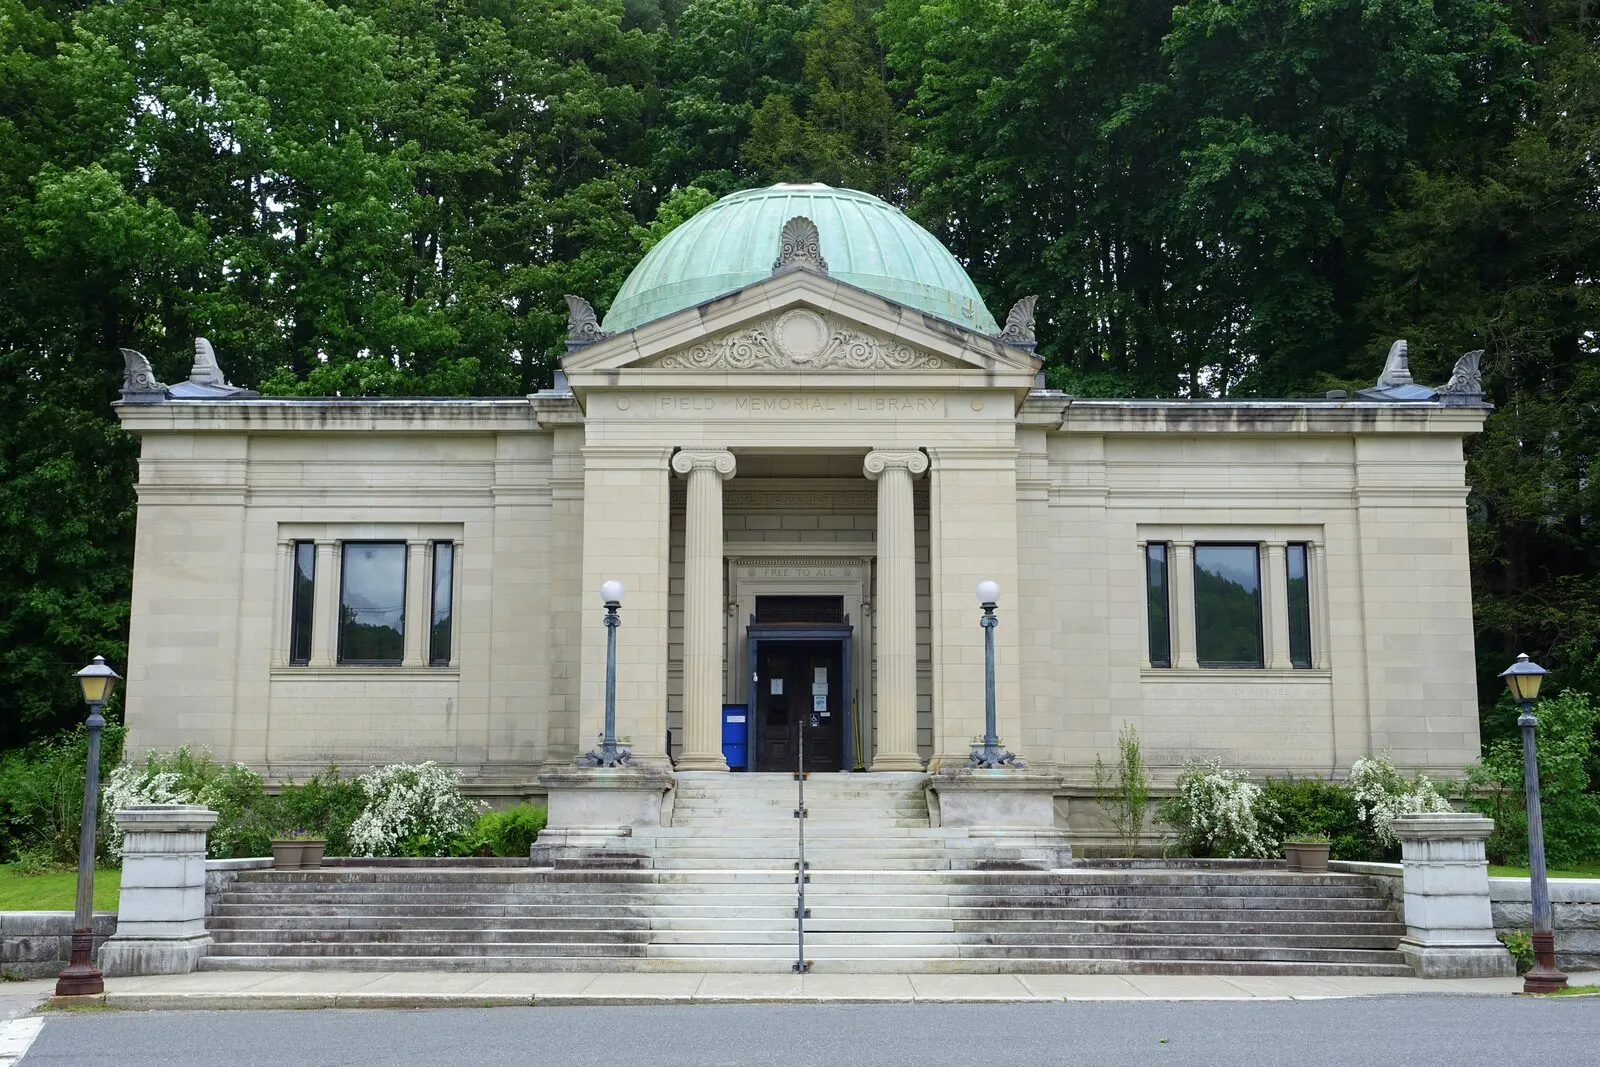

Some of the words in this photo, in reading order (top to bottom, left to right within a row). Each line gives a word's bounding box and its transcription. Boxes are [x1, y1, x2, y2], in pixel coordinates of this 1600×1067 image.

[660, 398, 716, 411] FIELD
[735, 398, 836, 411] MEMORIAL
[857, 398, 939, 411] LIBRARY
[764, 568, 789, 577] FREE
[795, 568, 810, 577] TO
[815, 568, 834, 577] ALL
